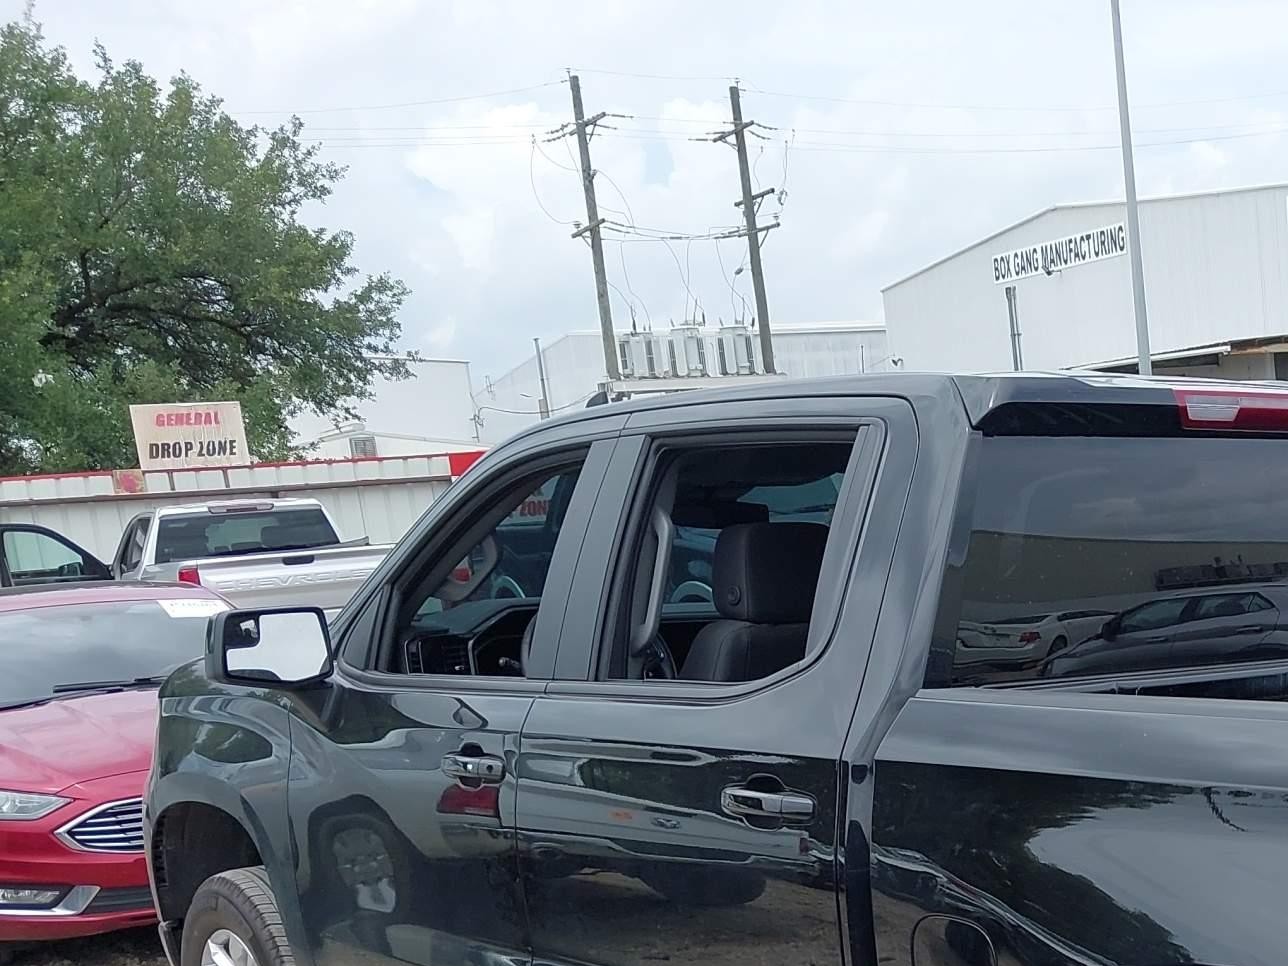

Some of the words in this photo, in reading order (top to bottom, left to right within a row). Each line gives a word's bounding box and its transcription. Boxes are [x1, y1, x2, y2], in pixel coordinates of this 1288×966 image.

[993, 253, 1013, 281] BOX
[1013, 247, 1040, 276] GANG
[1040, 225, 1126, 270] MANUFACTURING
[155, 411, 220, 427] GENERAL
[149, 441, 194, 460] DROP
[197, 439, 237, 457] ZONE
[520, 500, 548, 517] ZON
